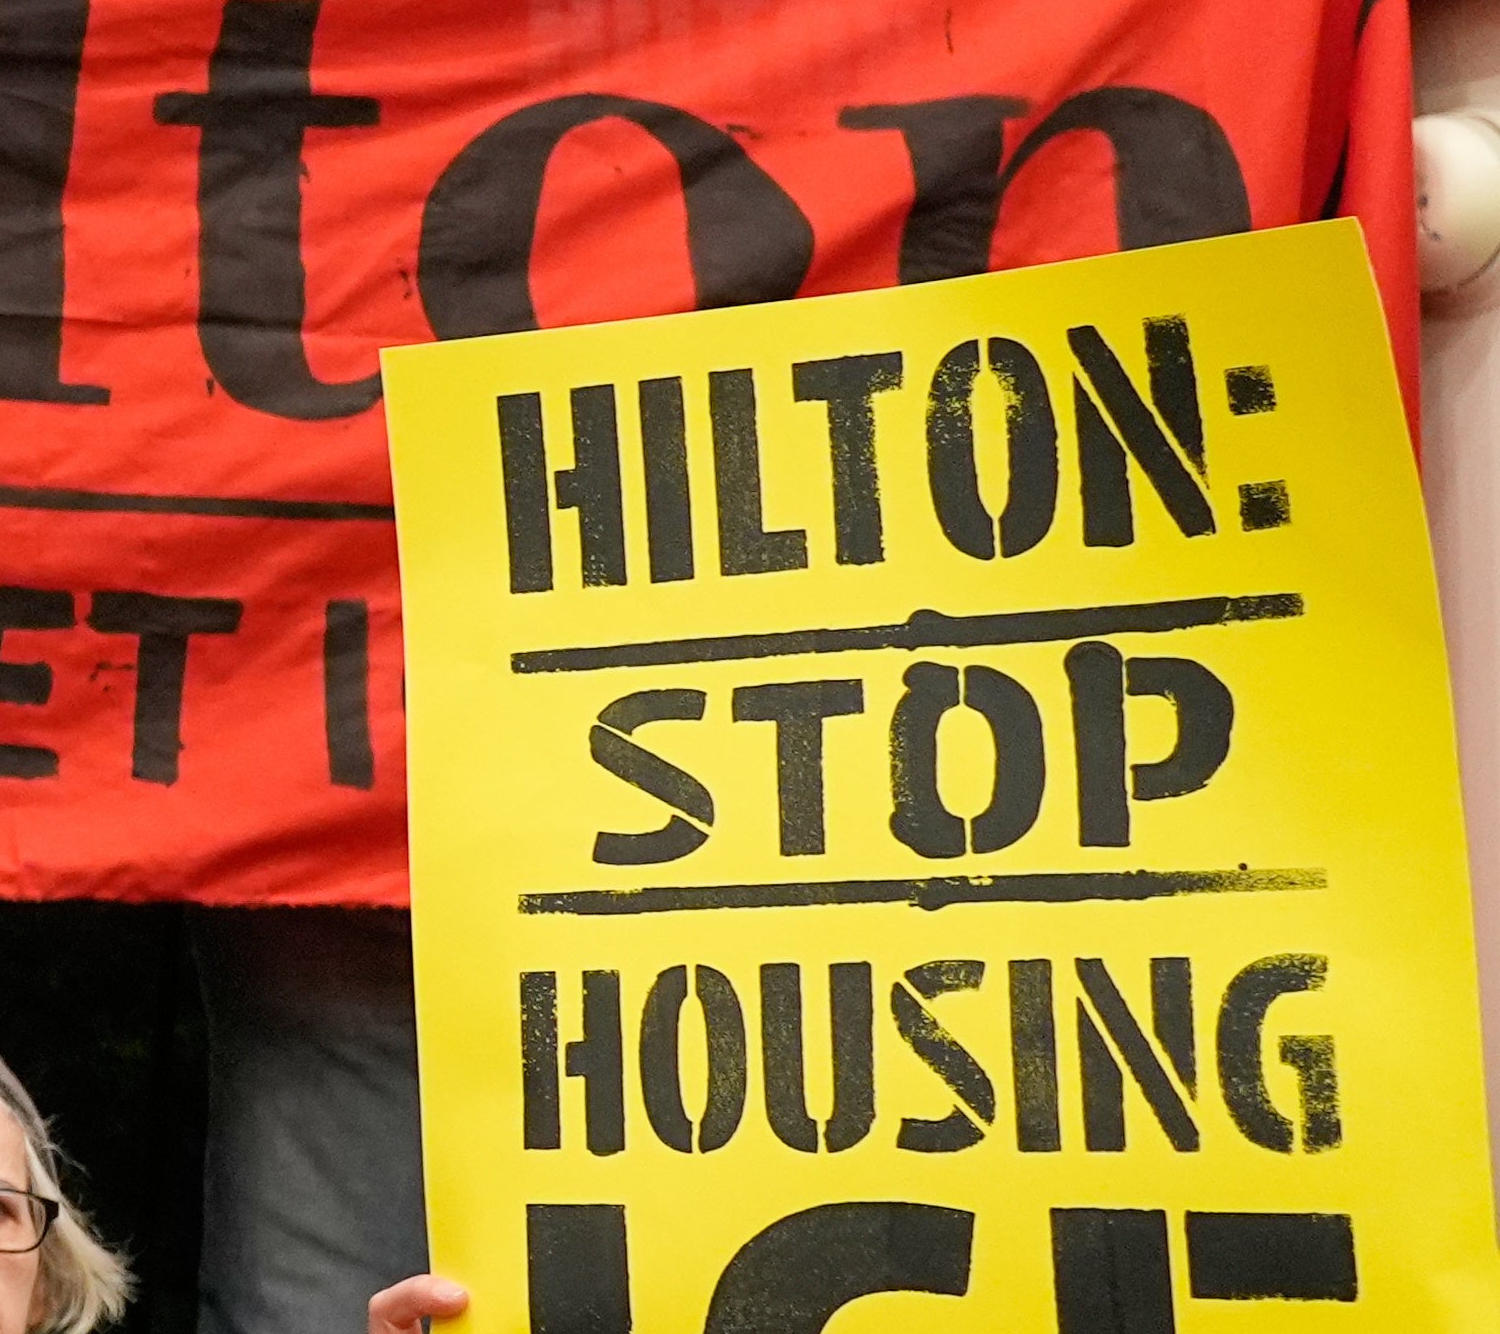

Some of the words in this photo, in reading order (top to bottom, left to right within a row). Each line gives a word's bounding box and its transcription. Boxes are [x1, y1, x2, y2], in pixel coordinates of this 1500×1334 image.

[495, 313, 1291, 594] HILTON:
[588, 638, 1235, 866] STOP
[520, 952, 1343, 1159] HOUSING
